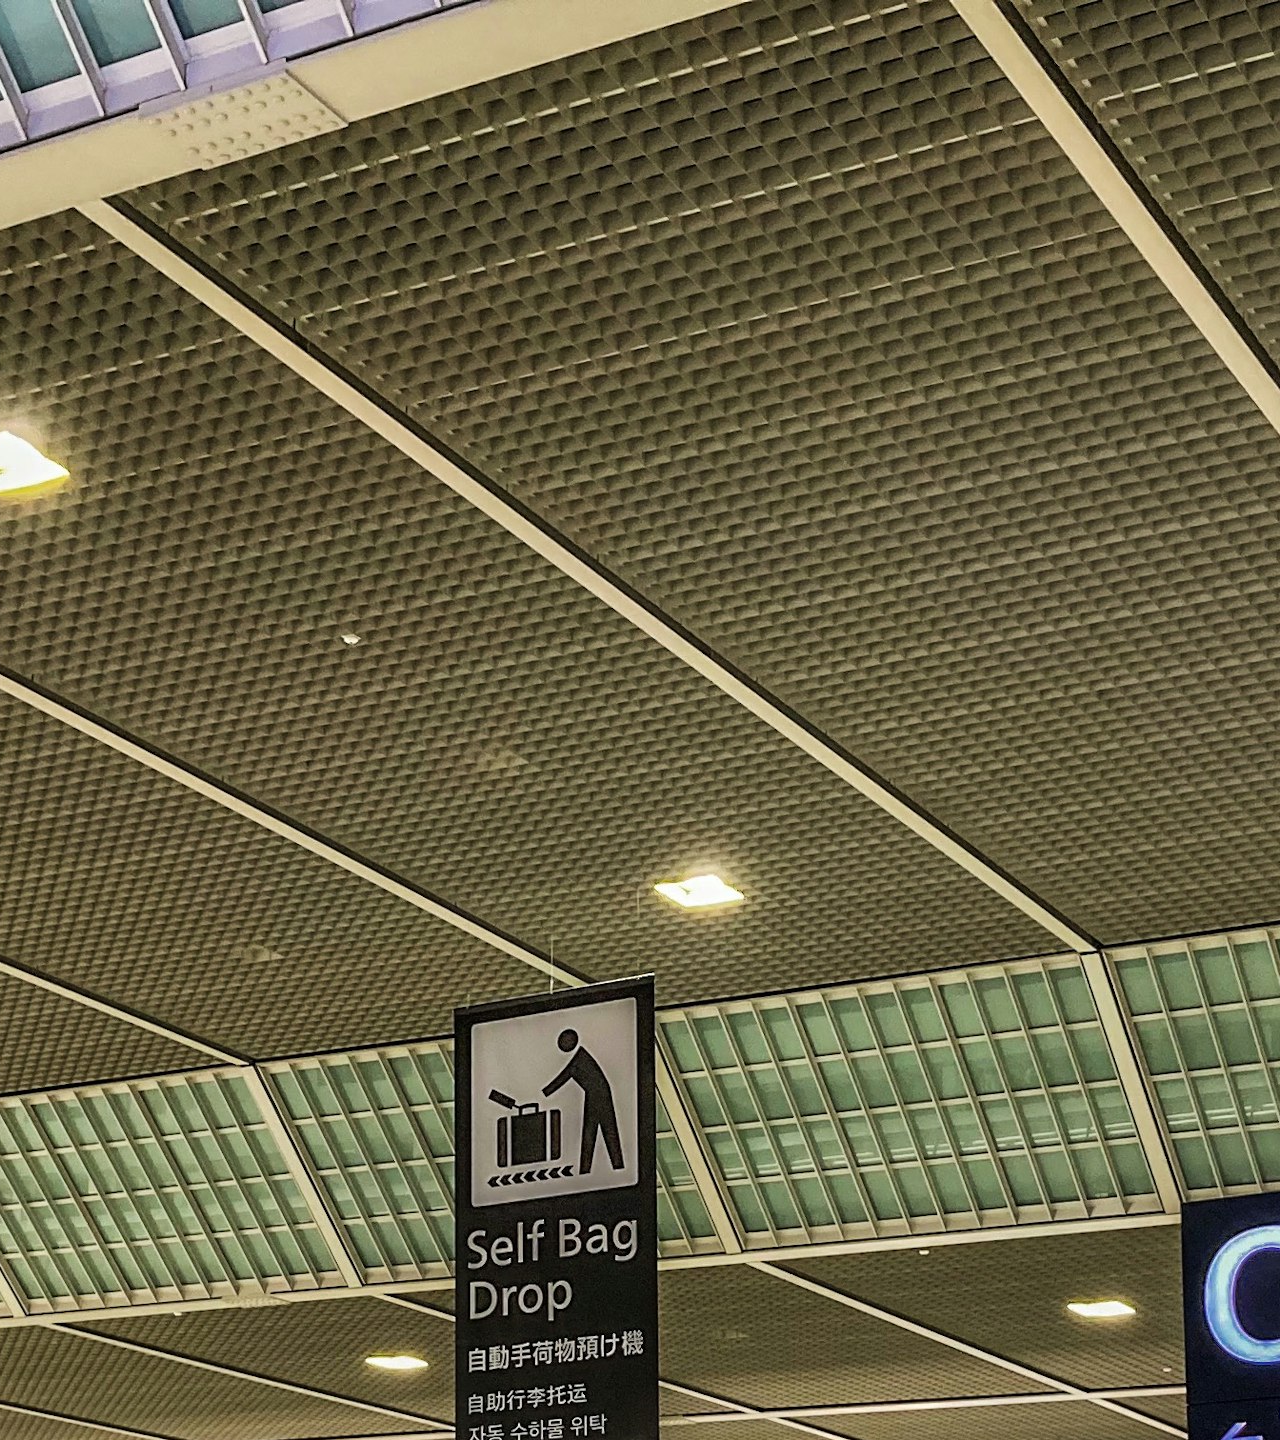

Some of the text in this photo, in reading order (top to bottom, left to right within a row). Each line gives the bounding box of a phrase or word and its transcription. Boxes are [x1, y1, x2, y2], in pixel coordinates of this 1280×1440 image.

[467, 1218, 638, 1270] Self Bag
[469, 1278, 573, 1322] Drop
[467, 1329, 644, 1374] 自動手荷物預け機
[467, 1382, 588, 1415] 自助行李托运
[570, 1413, 608, 1438] 위탁
